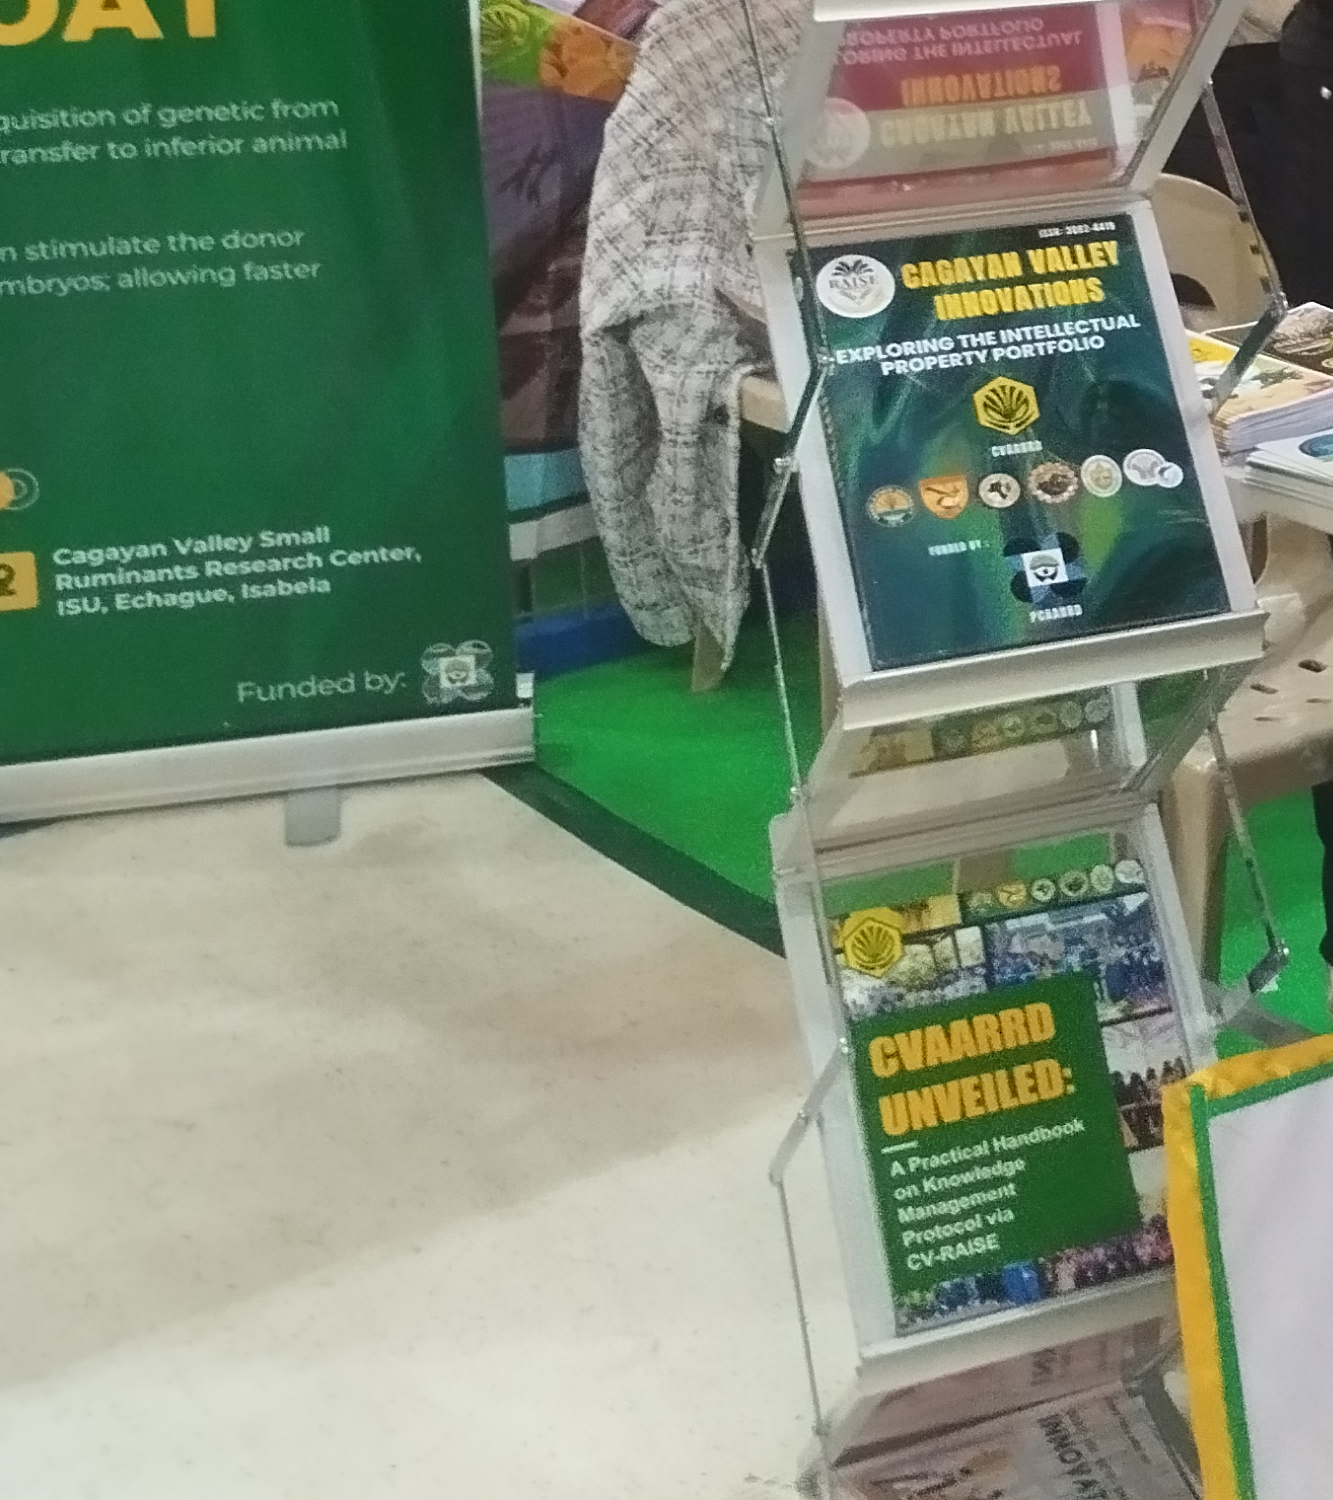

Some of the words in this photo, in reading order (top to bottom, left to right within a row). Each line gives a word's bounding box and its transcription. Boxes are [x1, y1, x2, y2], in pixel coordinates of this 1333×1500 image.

[122, 102, 152, 126] of
[157, 100, 265, 129] genetic
[270, 97, 340, 119] from
[106, 141, 138, 160] to
[252, 128, 348, 153] animal
[24, 235, 161, 261] stimulate
[166, 232, 216, 251] the
[221, 228, 304, 250] donor
[900, 250, 1023, 289] CAGAYAN
[1026, 240, 1119, 274] VALLEY
[117, 264, 236, 288] allowing
[243, 260, 322, 282] faster
[933, 277, 1105, 321] INNOVATIONS
[836, 338, 954, 365] EXPLORING
[957, 330, 998, 351] THE
[999, 314, 1141, 344] INTELLECTUAL
[881, 350, 988, 376] PROPERTY
[992, 335, 1105, 362] PORTFOLIO
[53, 541, 168, 567] Cagayan
[172, 532, 253, 556] Valley
[259, 526, 331, 548] Small
[55, 564, 200, 591] Ruminants
[204, 555, 323, 578] Research
[329, 544, 423, 567] Center,
[57, 597, 108, 617] ISU,
[114, 585, 236, 611] Echague,
[241, 577, 331, 598] Isabela
[236, 672, 356, 703] Funded
[363, 668, 407, 695] by:
[868, 1002, 1055, 1078] CVAARRD
[878, 1058, 1074, 1136] UNVEILED:
[890, 1160, 907, 1177] A
[908, 1146, 990, 1174] Practical
[993, 1118, 1085, 1153] Handbook
[893, 1185, 920, 1200] on
[923, 1158, 1027, 1196] Knowledge
[896, 1183, 1016, 1224] Management
[902, 1218, 982, 1248] Protocol
[985, 1208, 1015, 1228] via
[906, 1234, 1000, 1271] CV-RAISE
